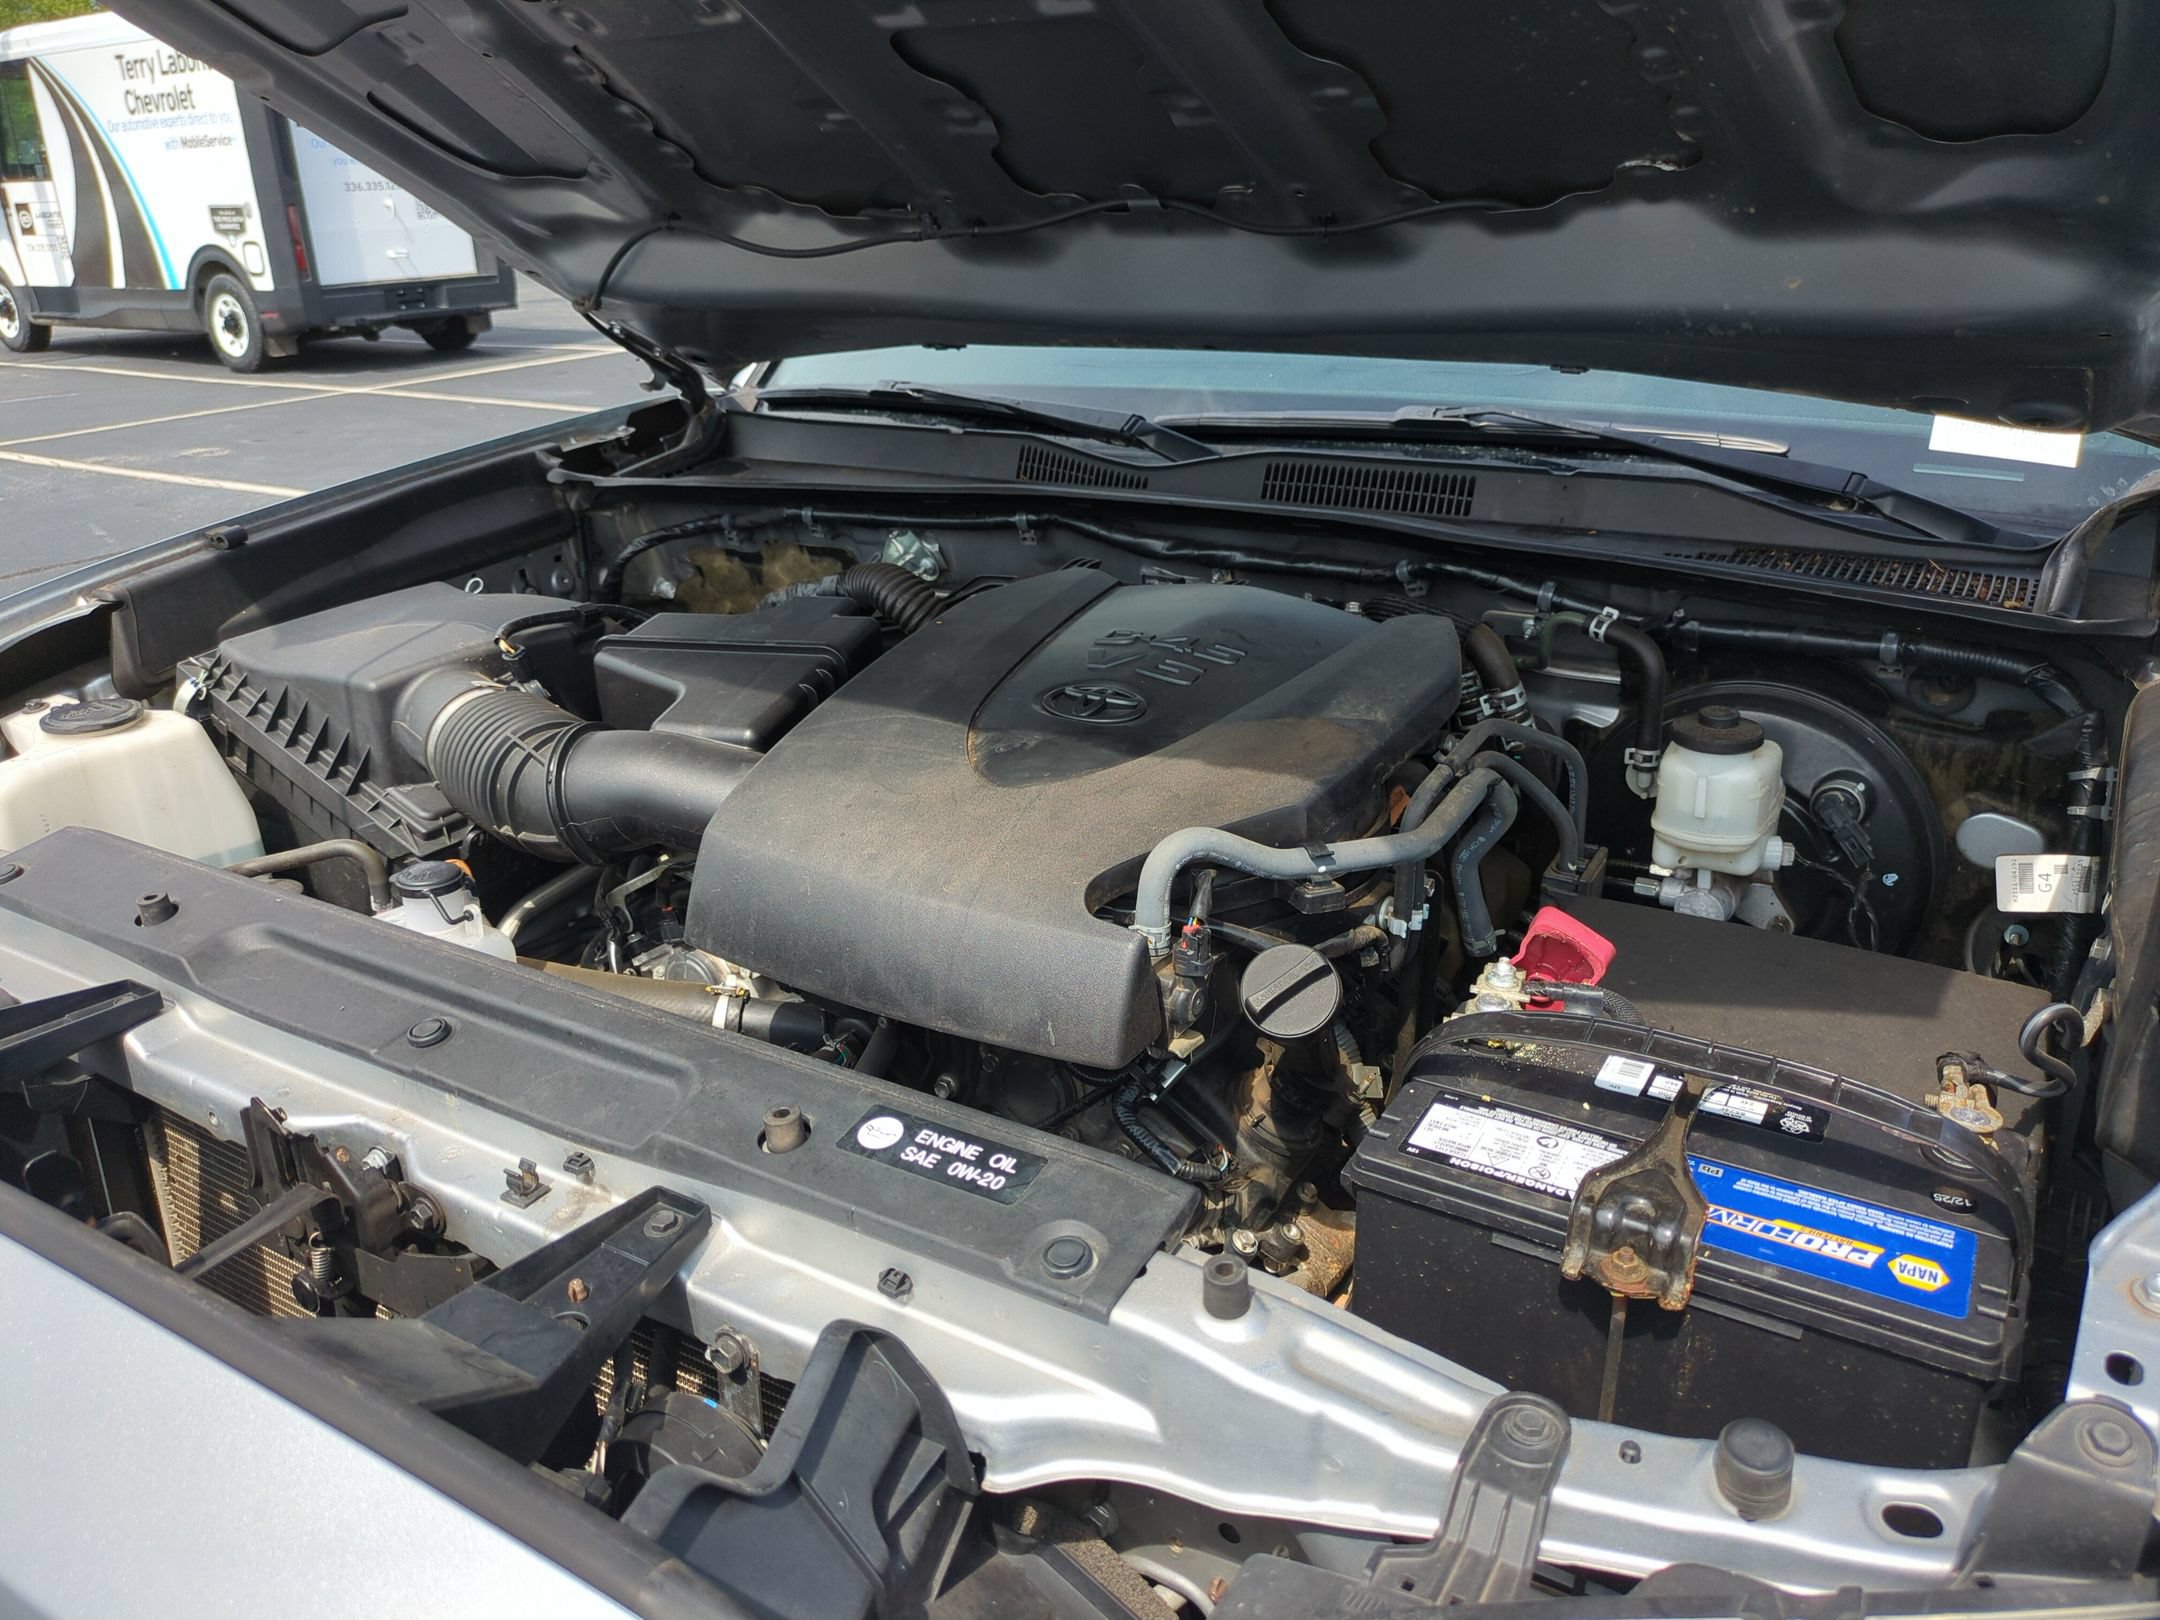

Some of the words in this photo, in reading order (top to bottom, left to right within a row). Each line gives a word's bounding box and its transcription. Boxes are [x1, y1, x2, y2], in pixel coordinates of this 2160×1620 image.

[115, 53, 155, 84] Terry
[156, 49, 212, 76] Labo
[124, 83, 196, 115] Chevrolet
[121, 118, 157, 132] automotive
[156, 116, 186, 129] experts
[180, 134, 233, 149] MobileService
[344, 181, 400, 193] 336.335.12
[2037, 872, 2053, 893] G4
[914, 1129, 983, 1161] ENGINE
[988, 1153, 1017, 1174] OIL
[900, 1146, 941, 1169] SAE
[946, 1161, 1006, 1191] 0W-20
[1449, 1156, 1568, 1199] DANGER/POISON
[1701, 1164, 1721, 1176] Pb
[1933, 1191, 1973, 1208] 12/25
[1800, 1226, 1854, 1246] BATTERIES
[1898, 1260, 1939, 1284] NAPA
